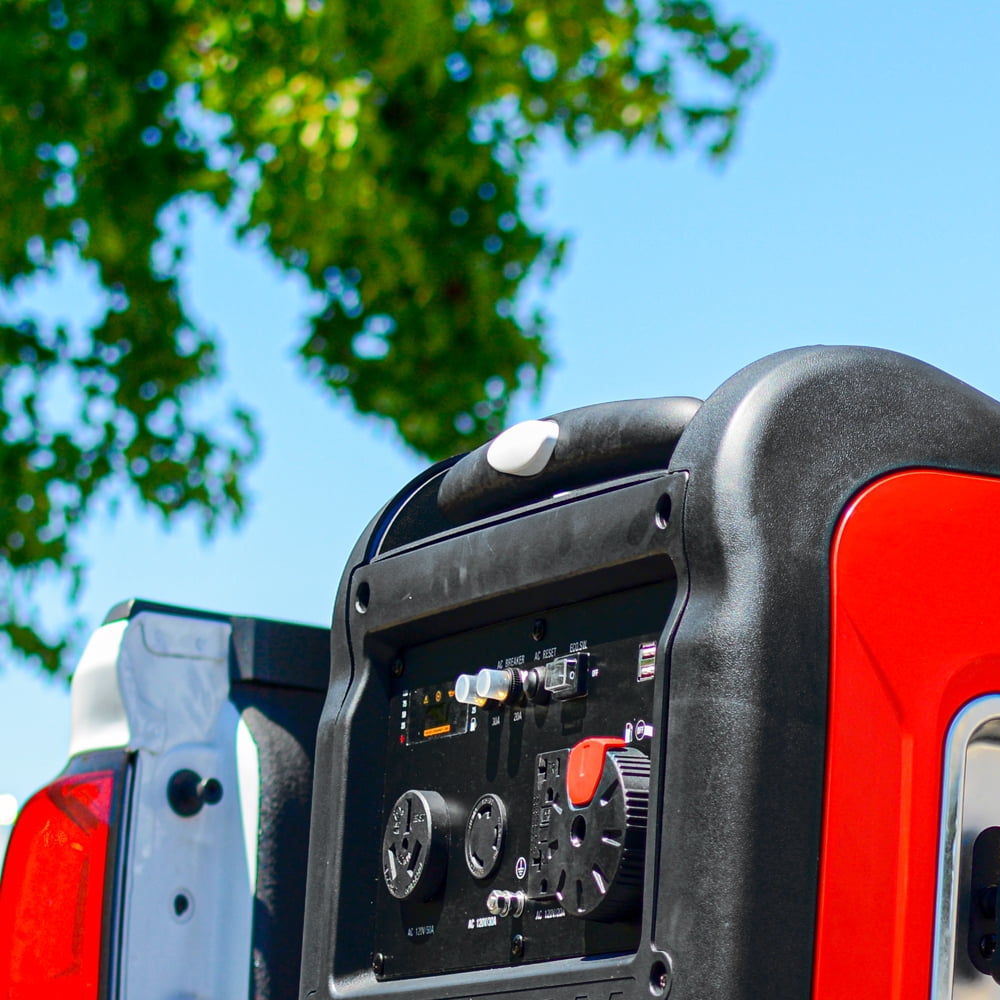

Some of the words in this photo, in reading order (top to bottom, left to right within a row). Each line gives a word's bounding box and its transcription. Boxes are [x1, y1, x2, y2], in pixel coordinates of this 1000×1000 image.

[534, 651, 541, 660] AC
[543, 647, 557, 659] RESET
[497, 660, 503, 669] AC
[505, 655, 525, 667] BREAKER
[535, 910, 542, 920] AC
[467, 919, 474, 929] AC
